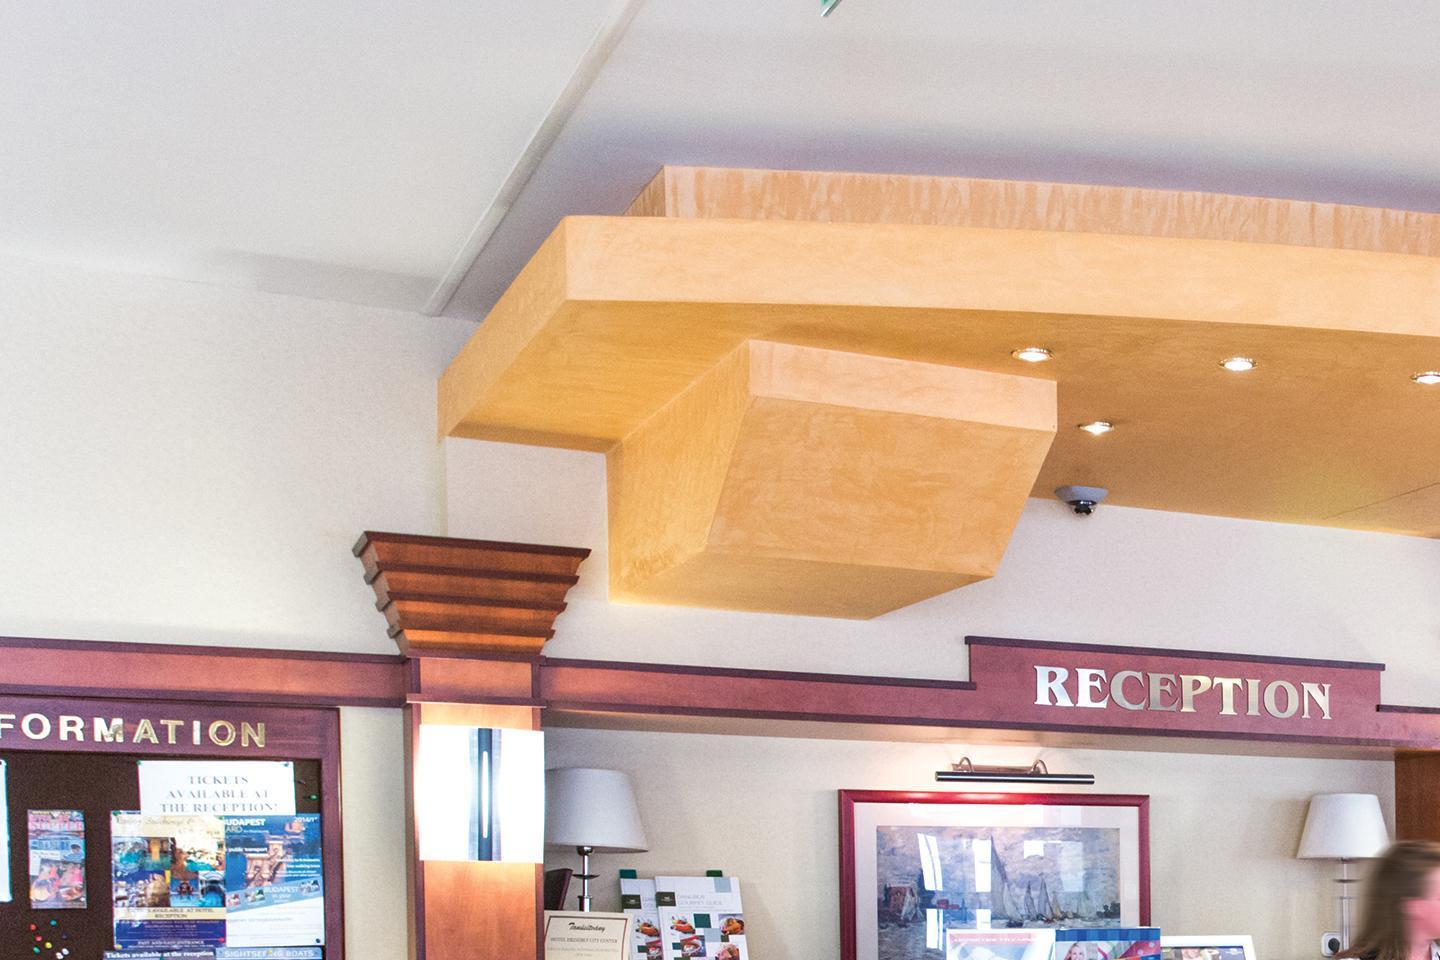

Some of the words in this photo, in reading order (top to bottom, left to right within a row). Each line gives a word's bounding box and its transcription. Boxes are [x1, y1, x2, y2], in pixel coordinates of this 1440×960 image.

[1033, 664, 1333, 721] RECEPTION
[0, 713, 267, 748] FORMATION
[187, 775, 250, 785] TICKETS
[167, 789, 250, 799] AVAILABLE
[255, 789, 271, 798] AT
[160, 803, 190, 813] THE
